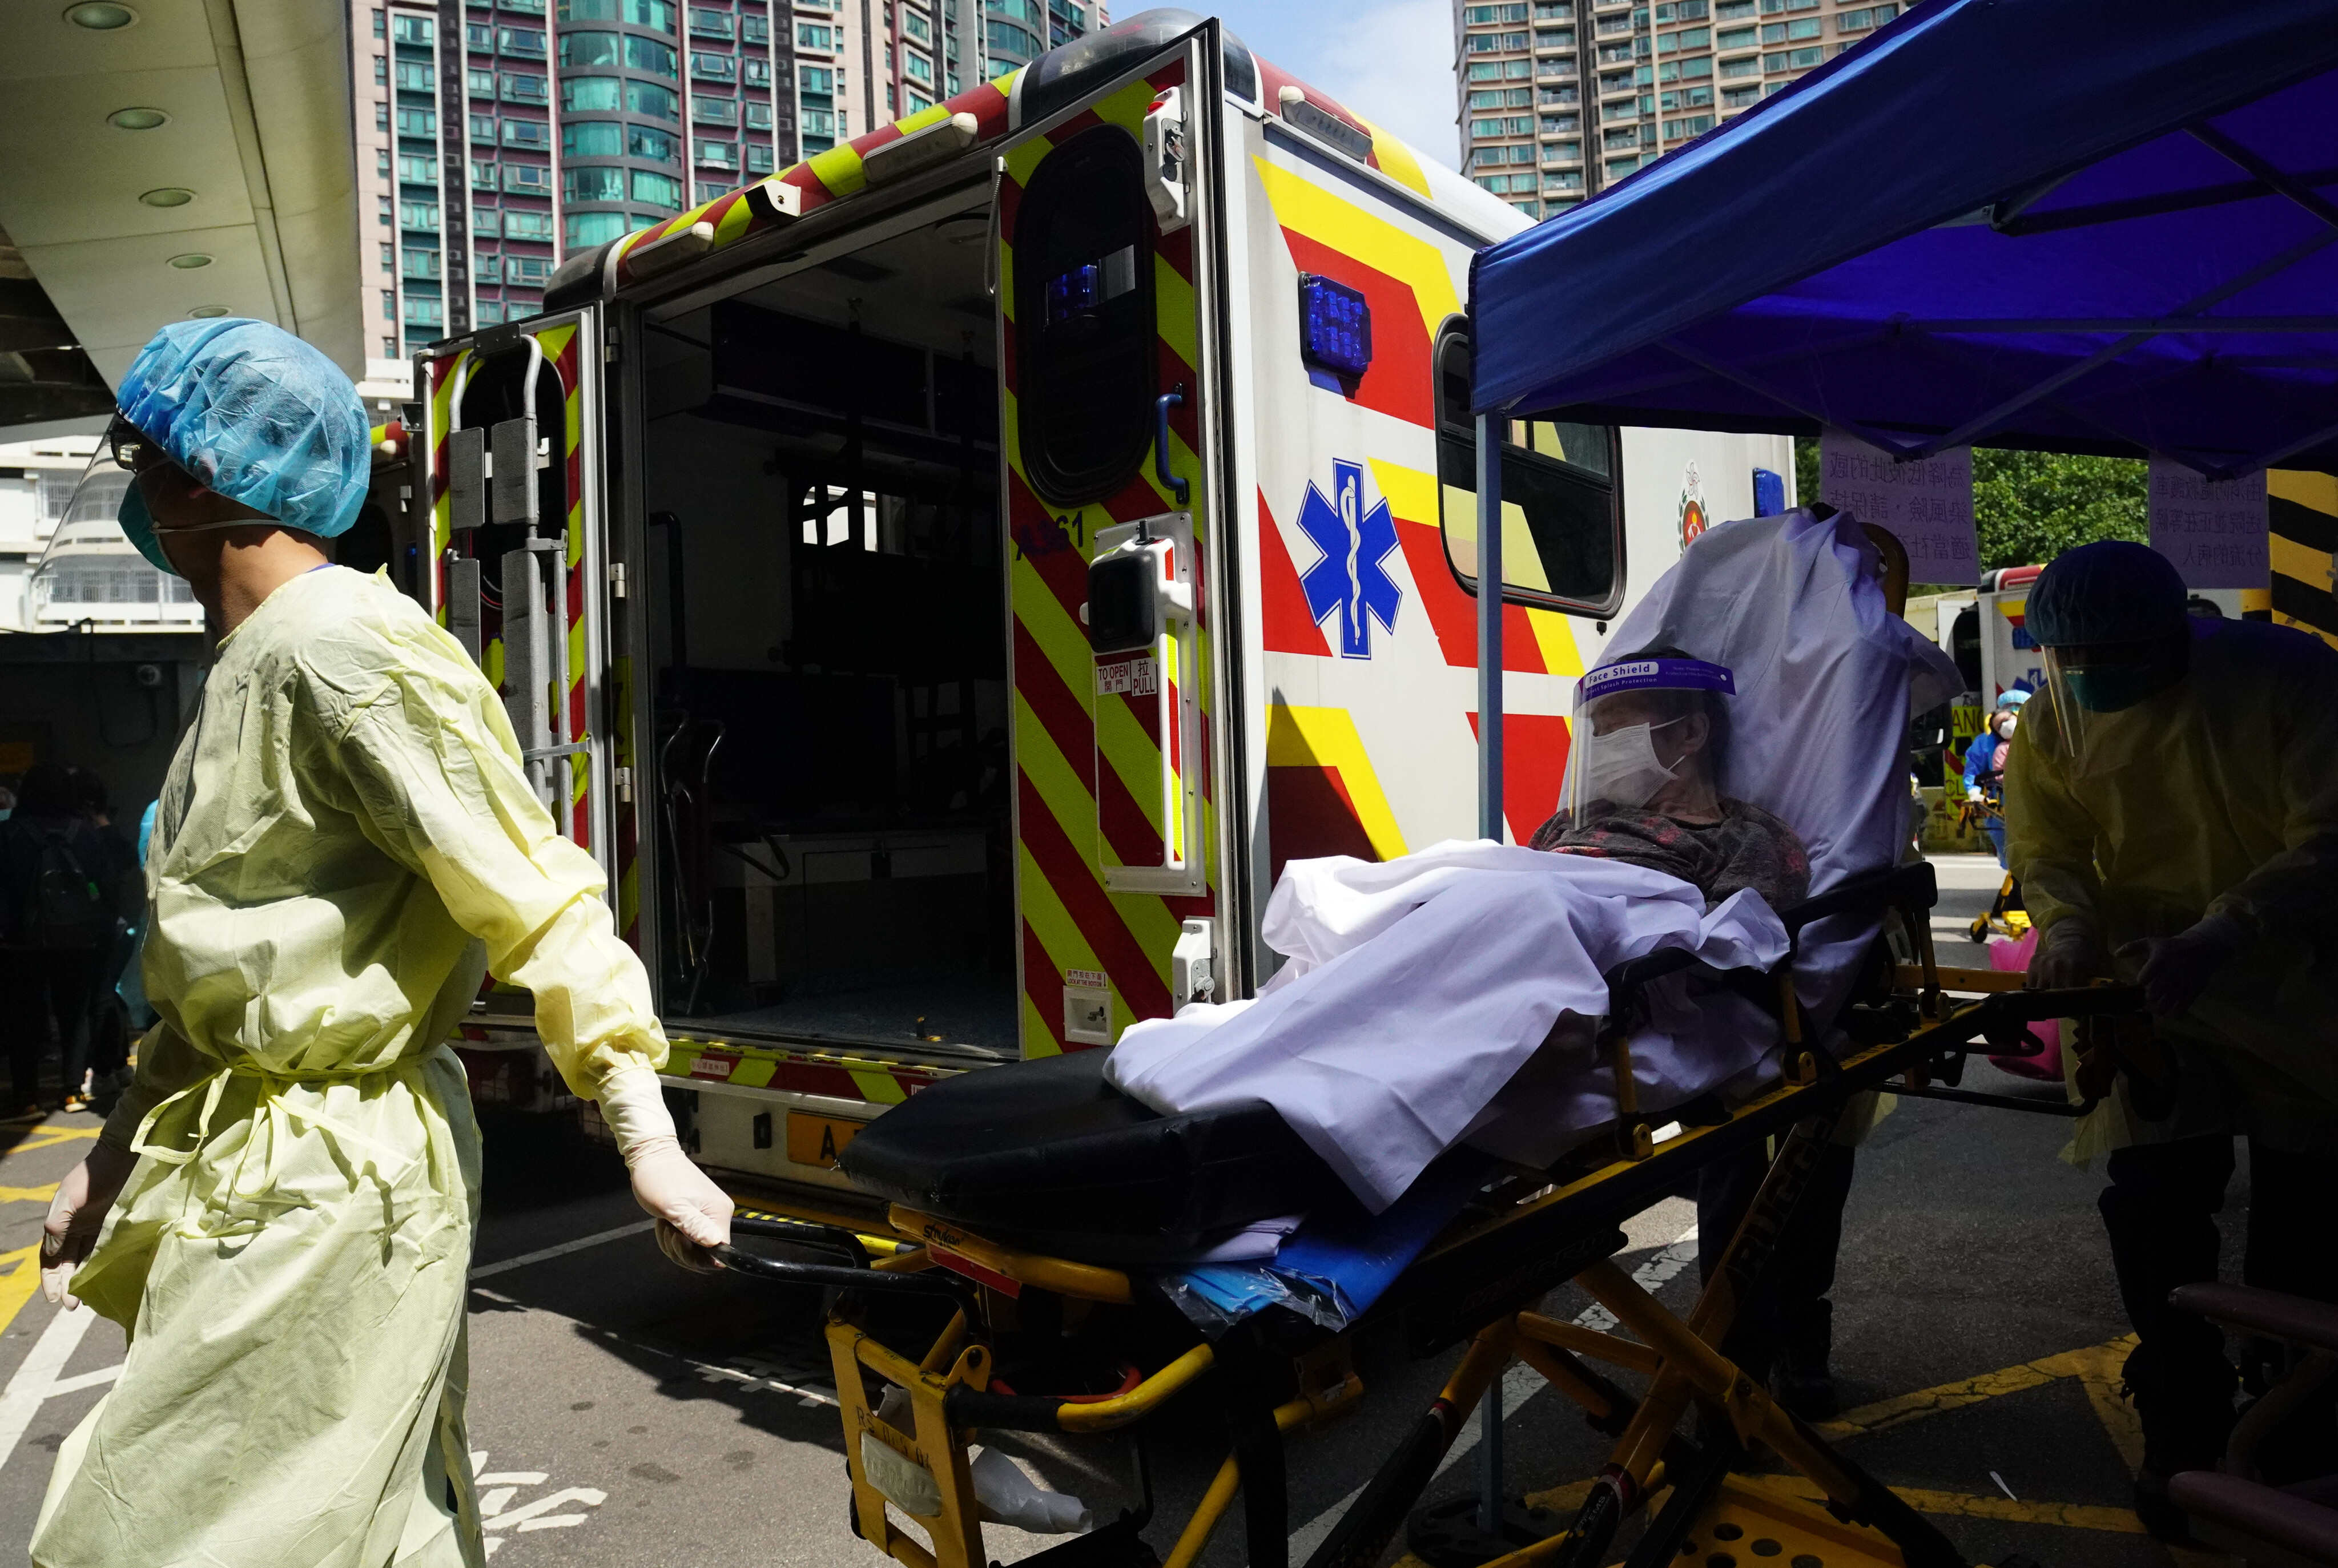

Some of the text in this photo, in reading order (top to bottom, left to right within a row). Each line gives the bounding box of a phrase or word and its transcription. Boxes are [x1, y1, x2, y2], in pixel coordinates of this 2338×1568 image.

[1098, 664, 1129, 681] TO OPEN
[1138, 660, 1149, 677] 拉
[1589, 664, 1649, 684] Face Shield
[1104, 679, 1123, 693] 開門
[1133, 676, 1155, 695] PULL
